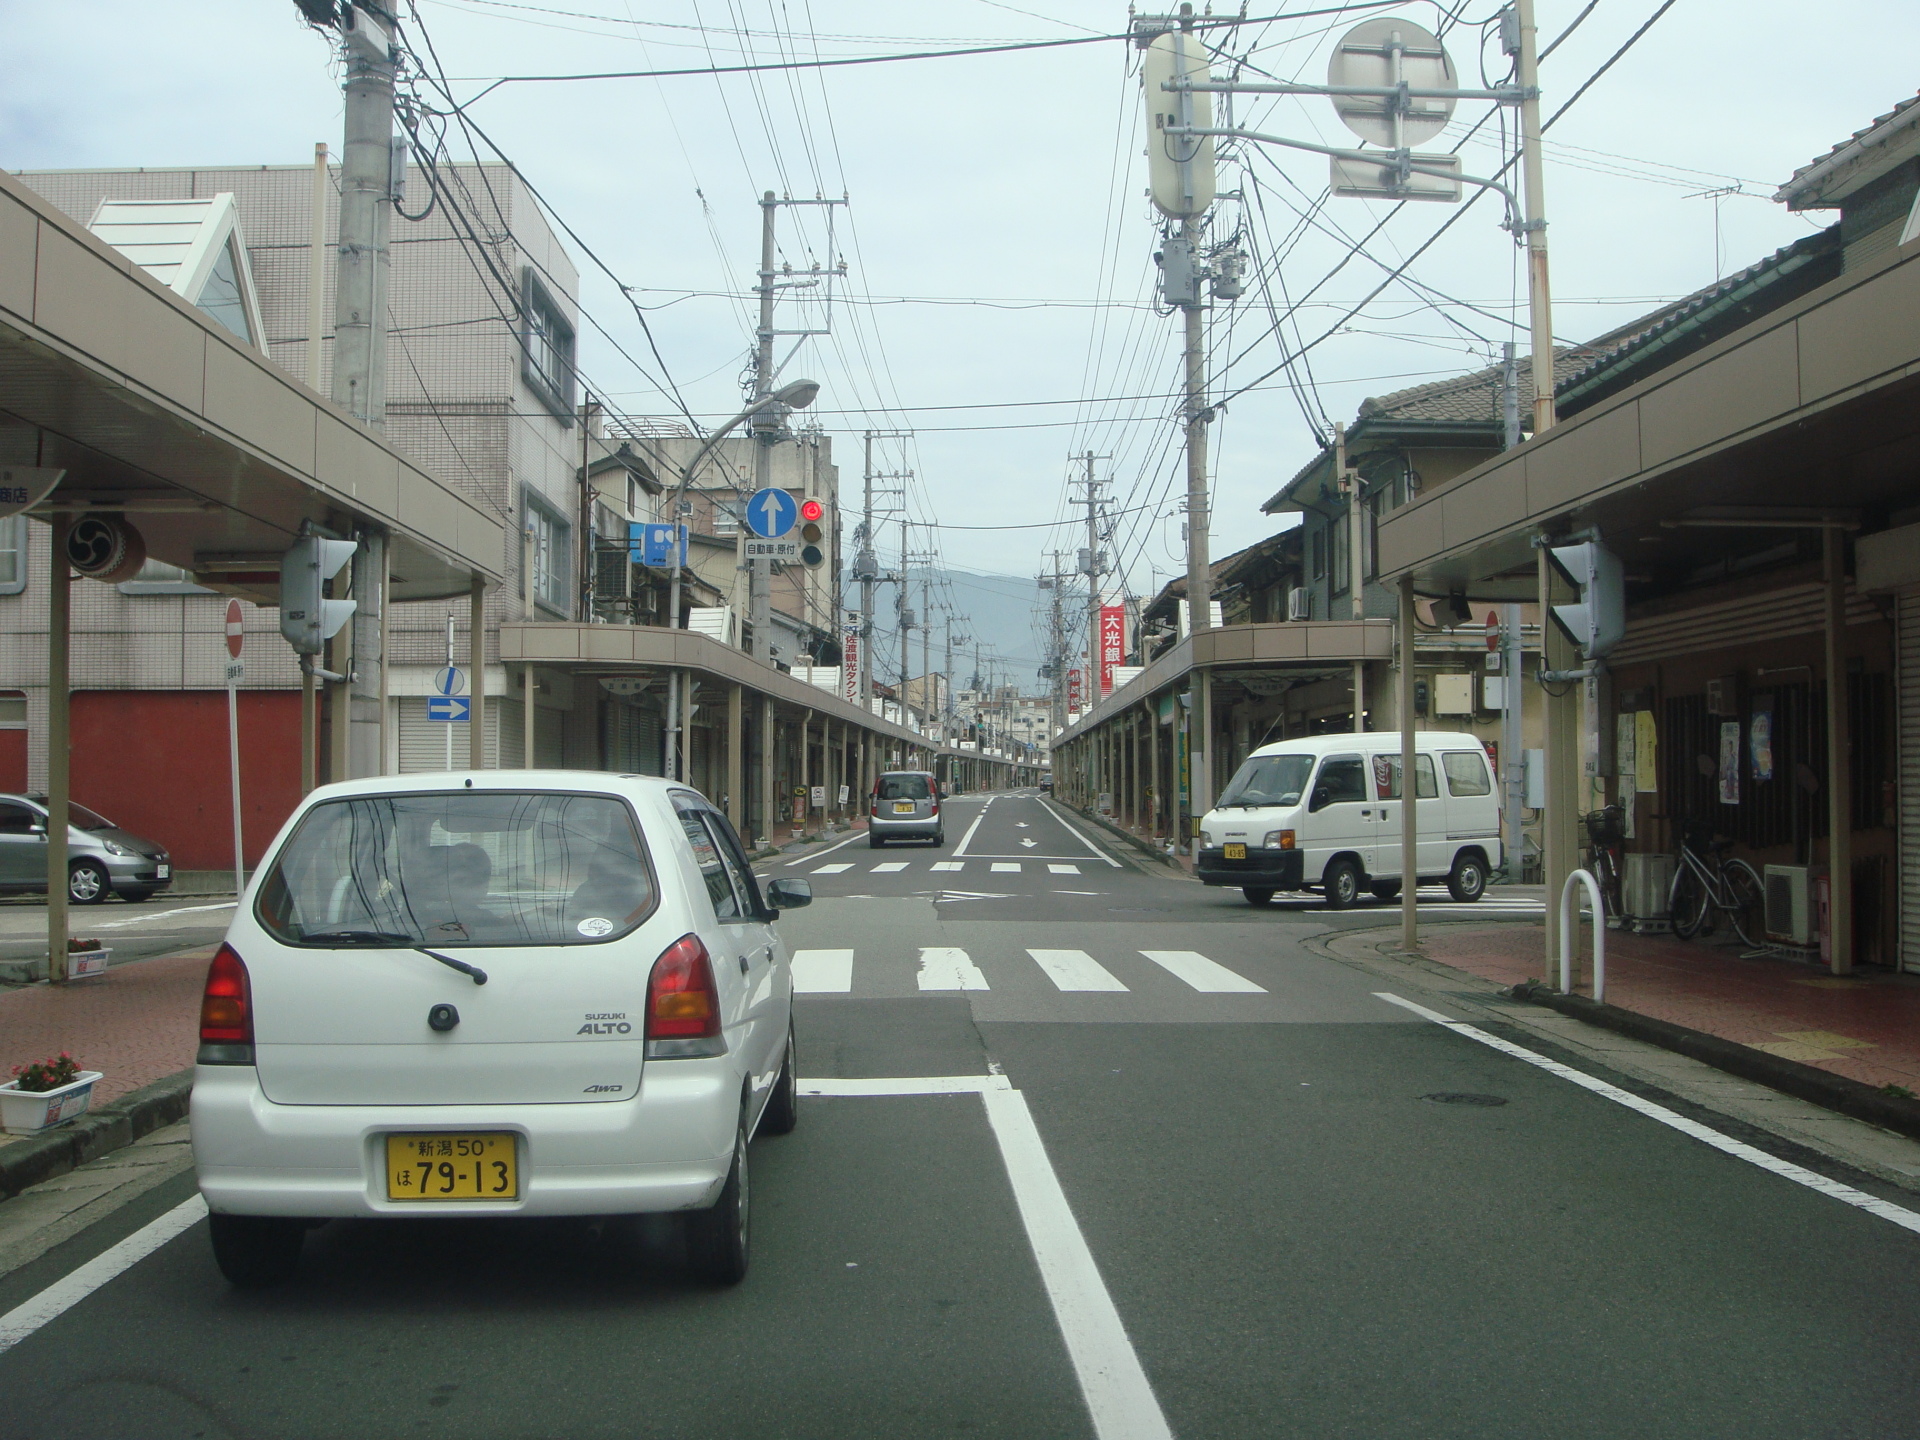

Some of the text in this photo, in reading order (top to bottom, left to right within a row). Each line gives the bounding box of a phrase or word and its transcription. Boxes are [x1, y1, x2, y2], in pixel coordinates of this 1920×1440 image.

[845, 635, 858, 703] 佐渡観光タクシー
[585, 1013, 626, 1021] SUZUKI
[577, 1022, 632, 1035] ALTO
[583, 1085, 623, 1094] 4WD
[396, 1160, 509, 1194] ほ 79-13
